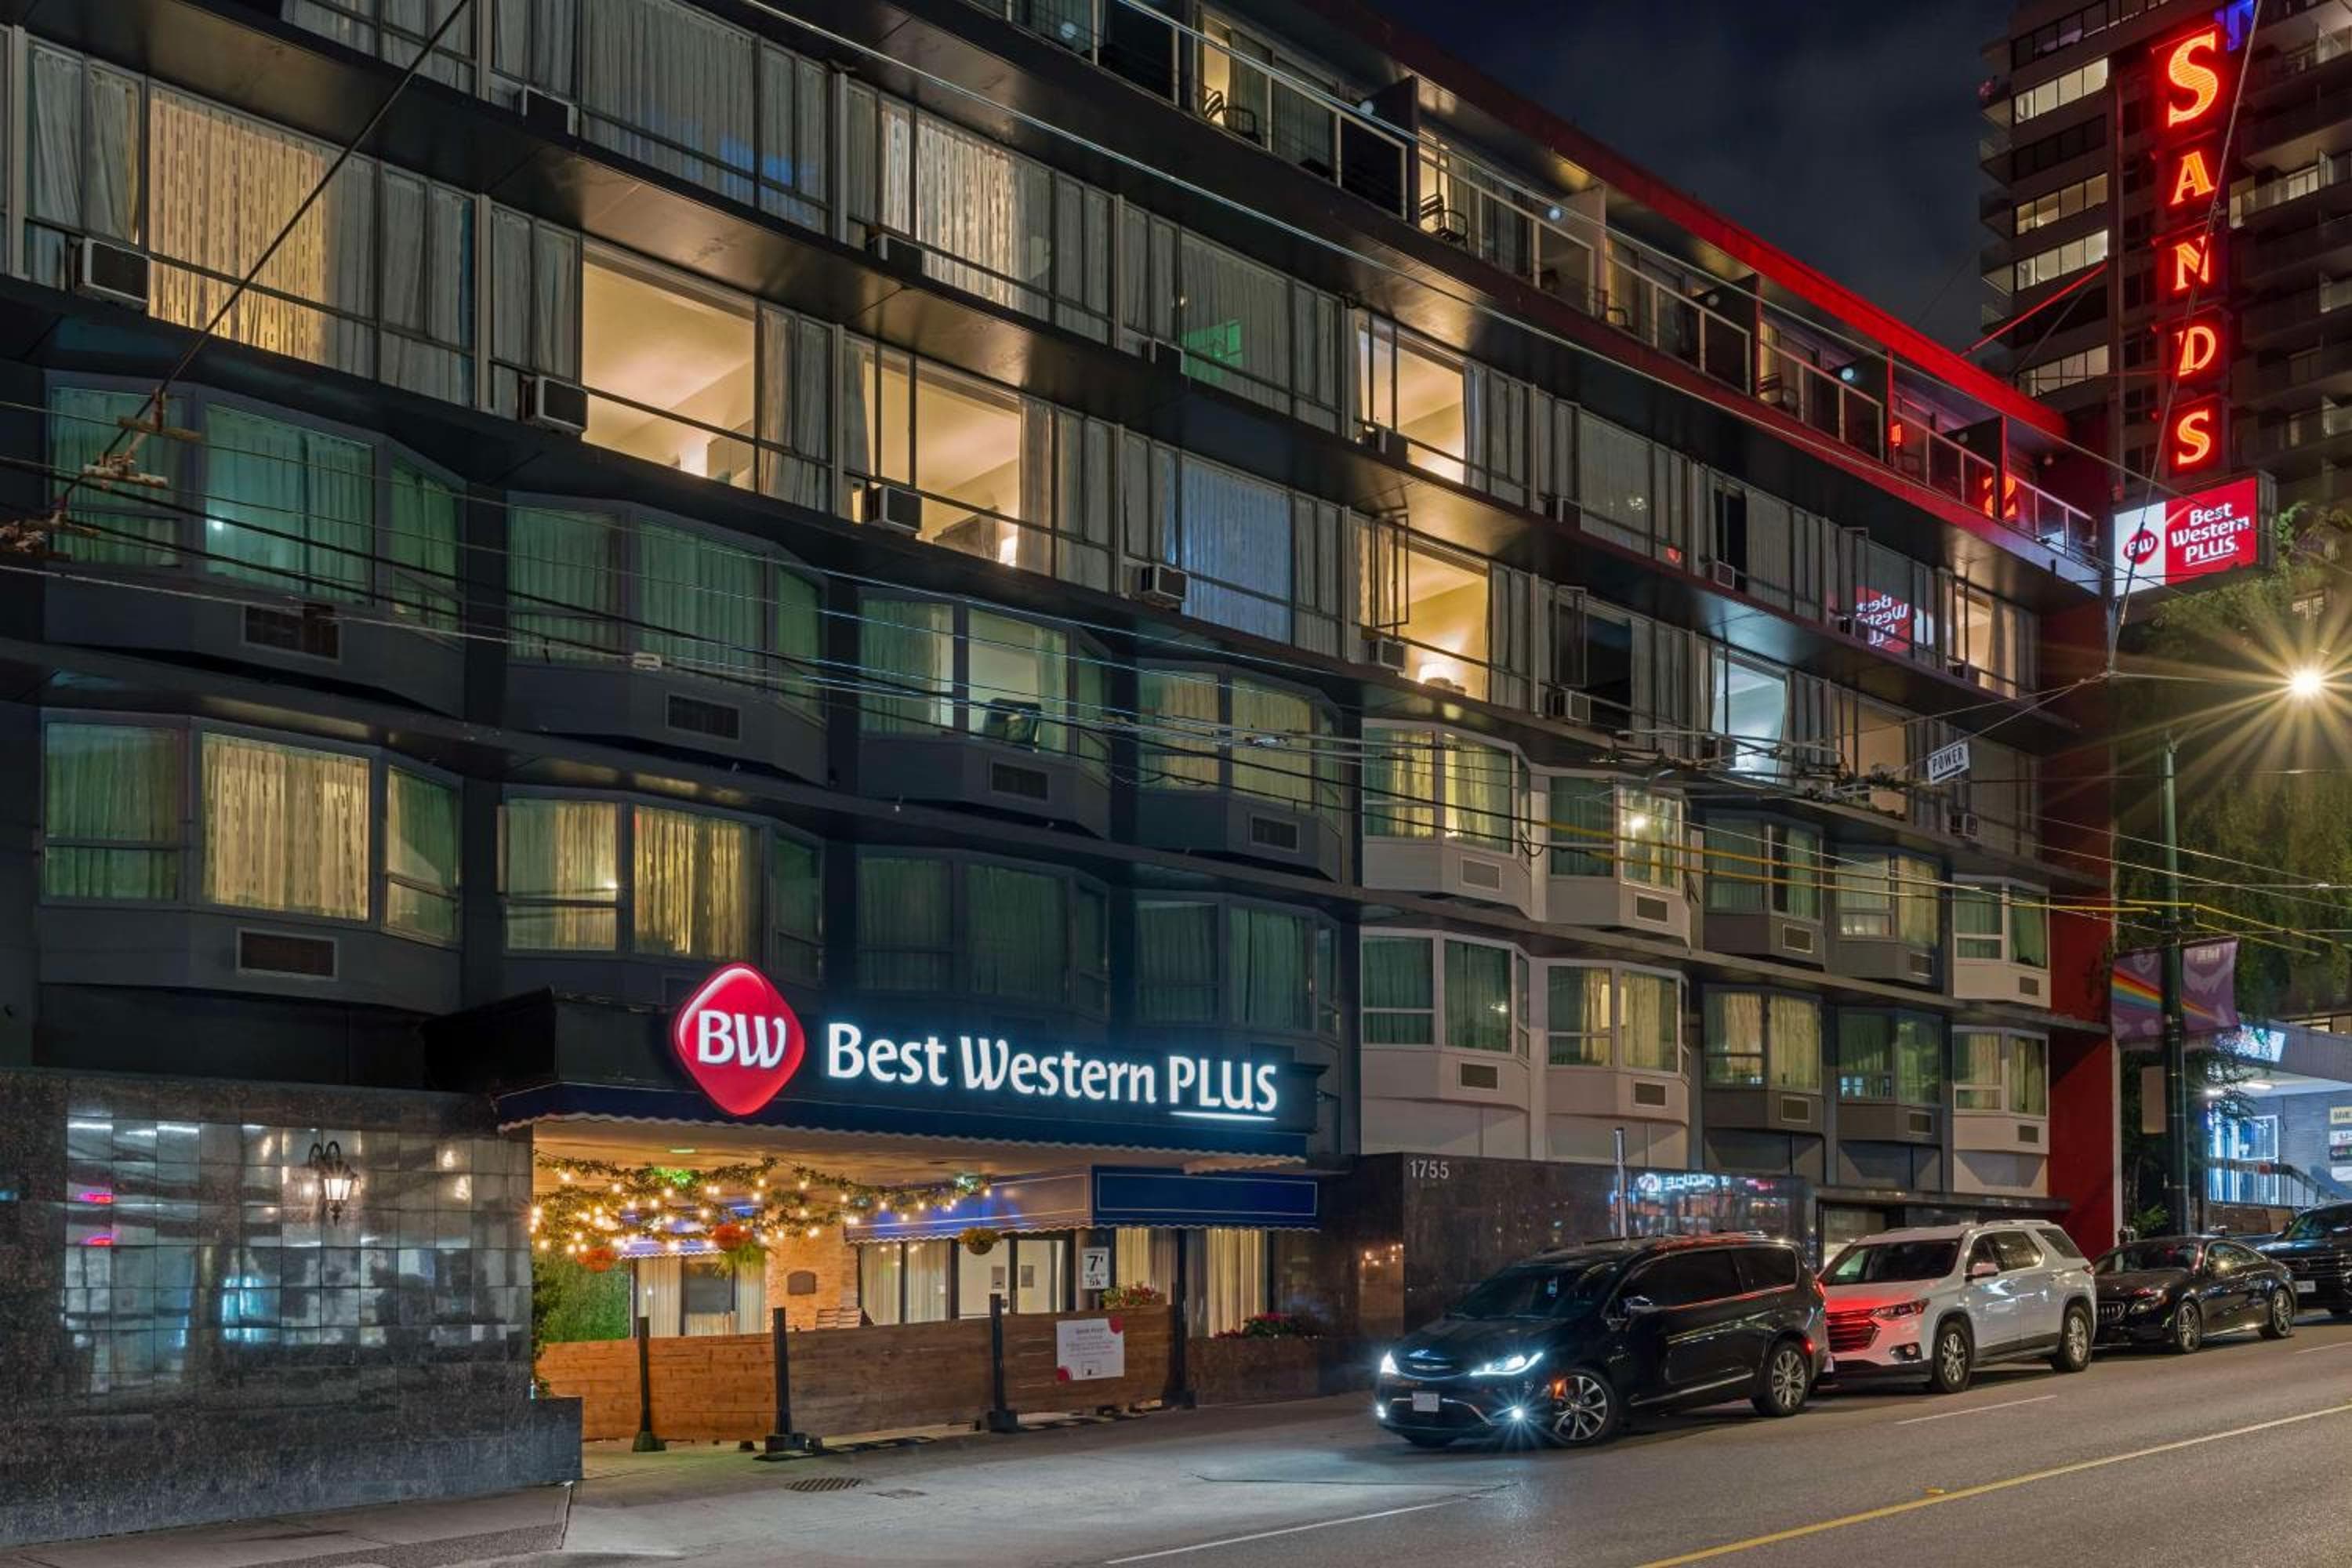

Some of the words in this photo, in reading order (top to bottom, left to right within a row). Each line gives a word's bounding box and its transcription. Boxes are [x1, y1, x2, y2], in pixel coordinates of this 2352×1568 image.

[2167, 30, 2219, 466] SANDS
[2170, 515, 2250, 548] Western
[2189, 502, 2234, 528] Best
[1932, 746, 1964, 773] POWER
[697, 1009, 786, 1069] BW
[827, 1022, 949, 1083] Best
[960, 1035, 1156, 1104] Western
[1169, 1054, 1278, 1112] PLUS
[1410, 1160, 1450, 1179] 1755
